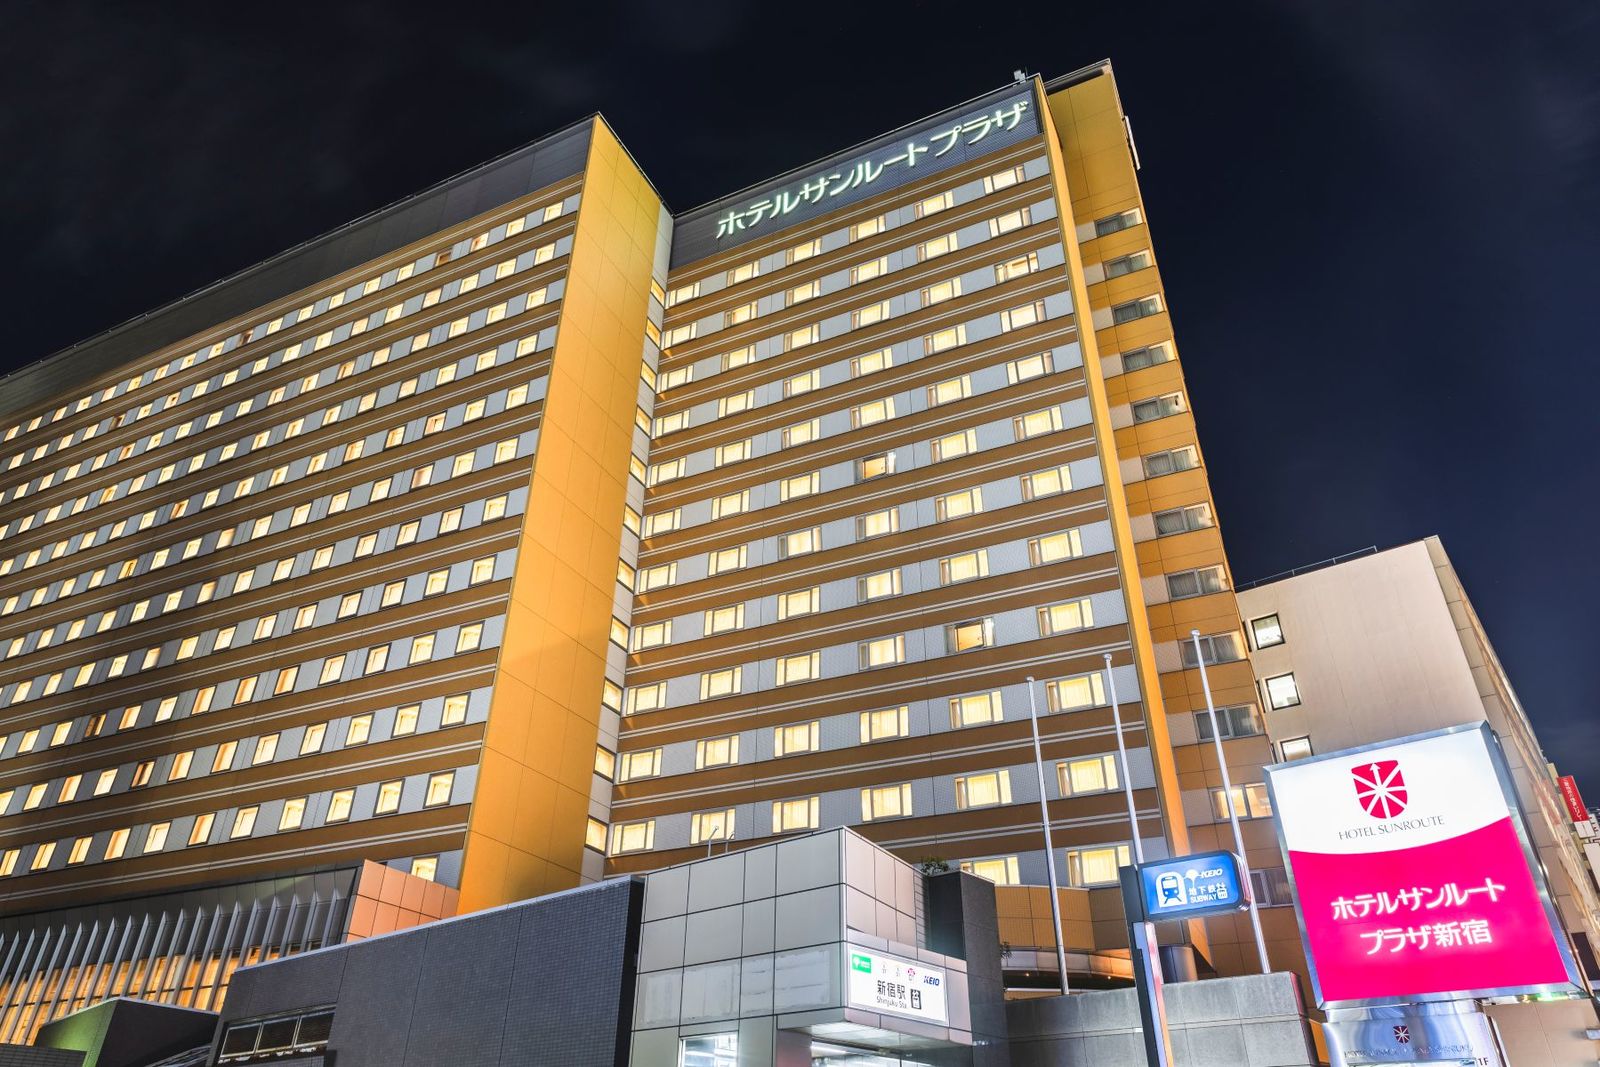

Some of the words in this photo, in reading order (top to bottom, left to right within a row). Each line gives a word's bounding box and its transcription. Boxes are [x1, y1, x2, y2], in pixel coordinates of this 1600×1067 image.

[1338, 826, 1377, 840] HOTEL
[1377, 815, 1446, 835] SUNROUTE
[1190, 893, 1217, 904] SUBWAY
[1330, 877, 1507, 921] ホテルサンルート
[1359, 918, 1493, 956] プラザ新宿
[877, 979, 906, 1000] 新宿駅
[923, 975, 940, 986] KEIO
[876, 996, 898, 1008] Shinjuku
